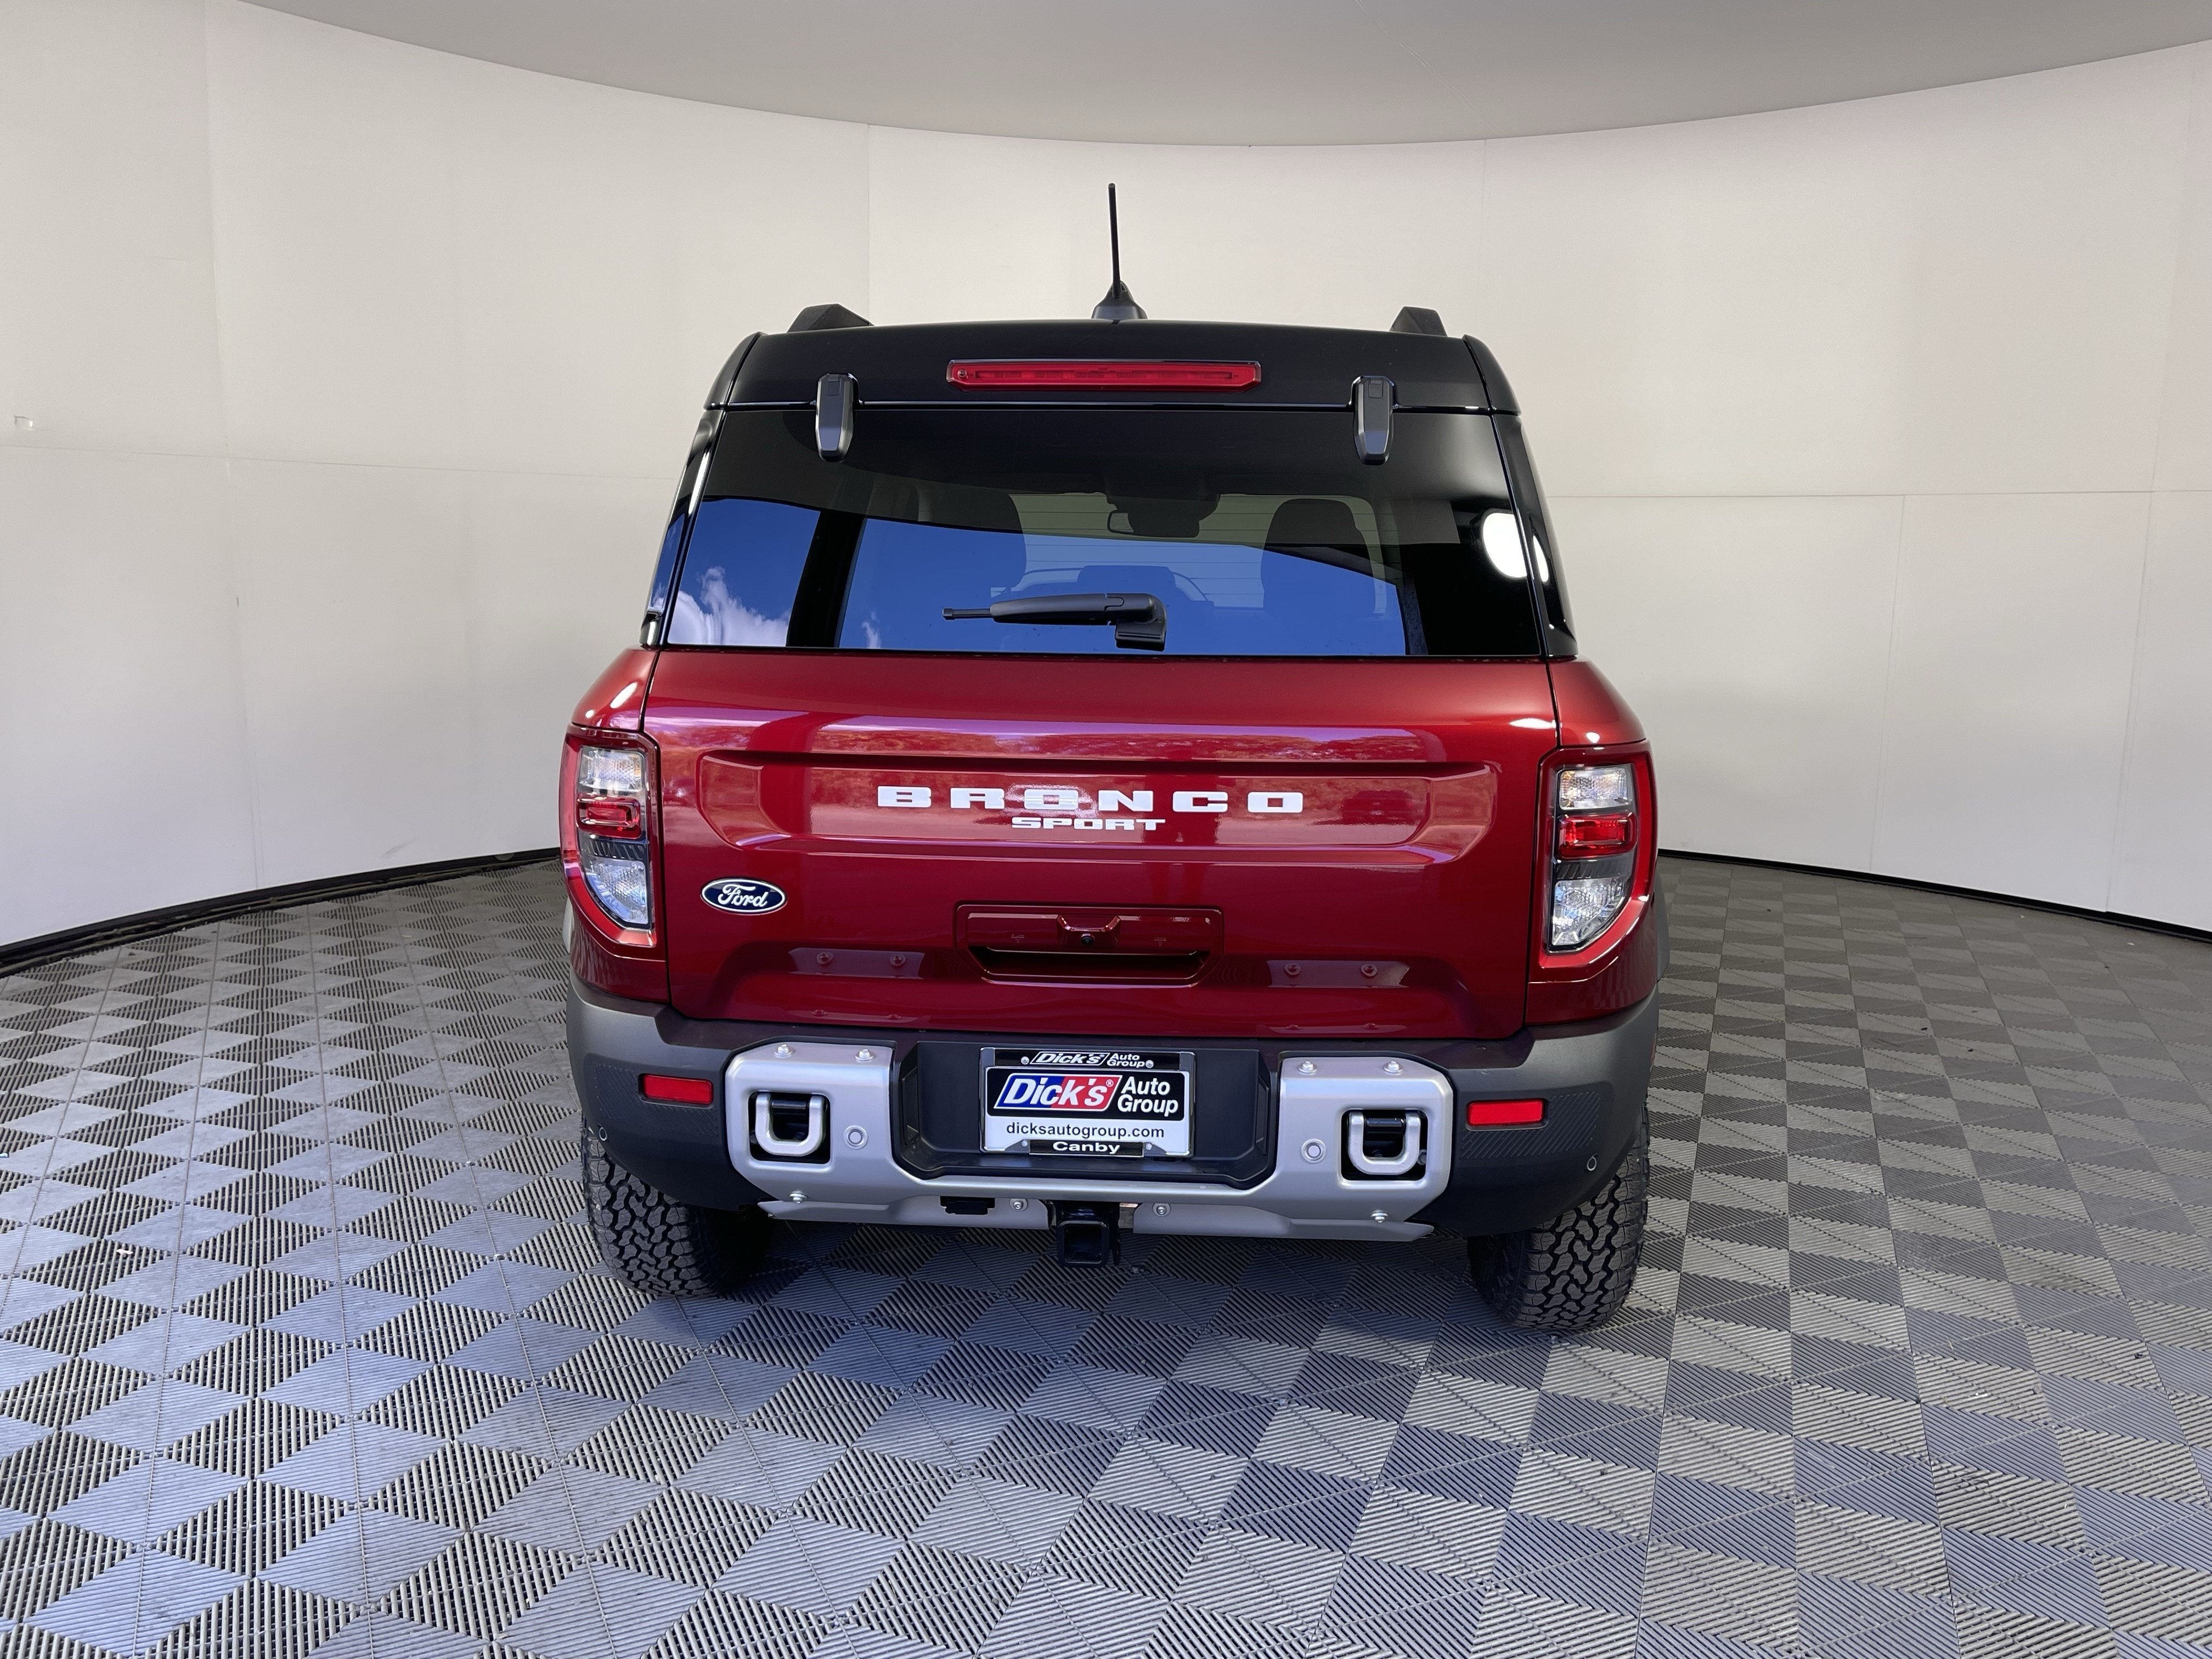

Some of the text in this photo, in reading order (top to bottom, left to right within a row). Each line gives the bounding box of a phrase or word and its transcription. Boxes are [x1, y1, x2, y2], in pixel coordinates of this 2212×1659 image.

[877, 786, 1304, 813] BRONCO
[1012, 817, 1166, 831] SPORT
[717, 883, 769, 907] Ford
[1107, 1059, 1146, 1068] Group
[1109, 1053, 1140, 1061] Auto
[1121, 1076, 1171, 1096] Auto
[1118, 1094, 1178, 1116] Group
[1006, 1121, 1165, 1139] dicksautogroup.com
[1053, 1141, 1120, 1155] Canby
